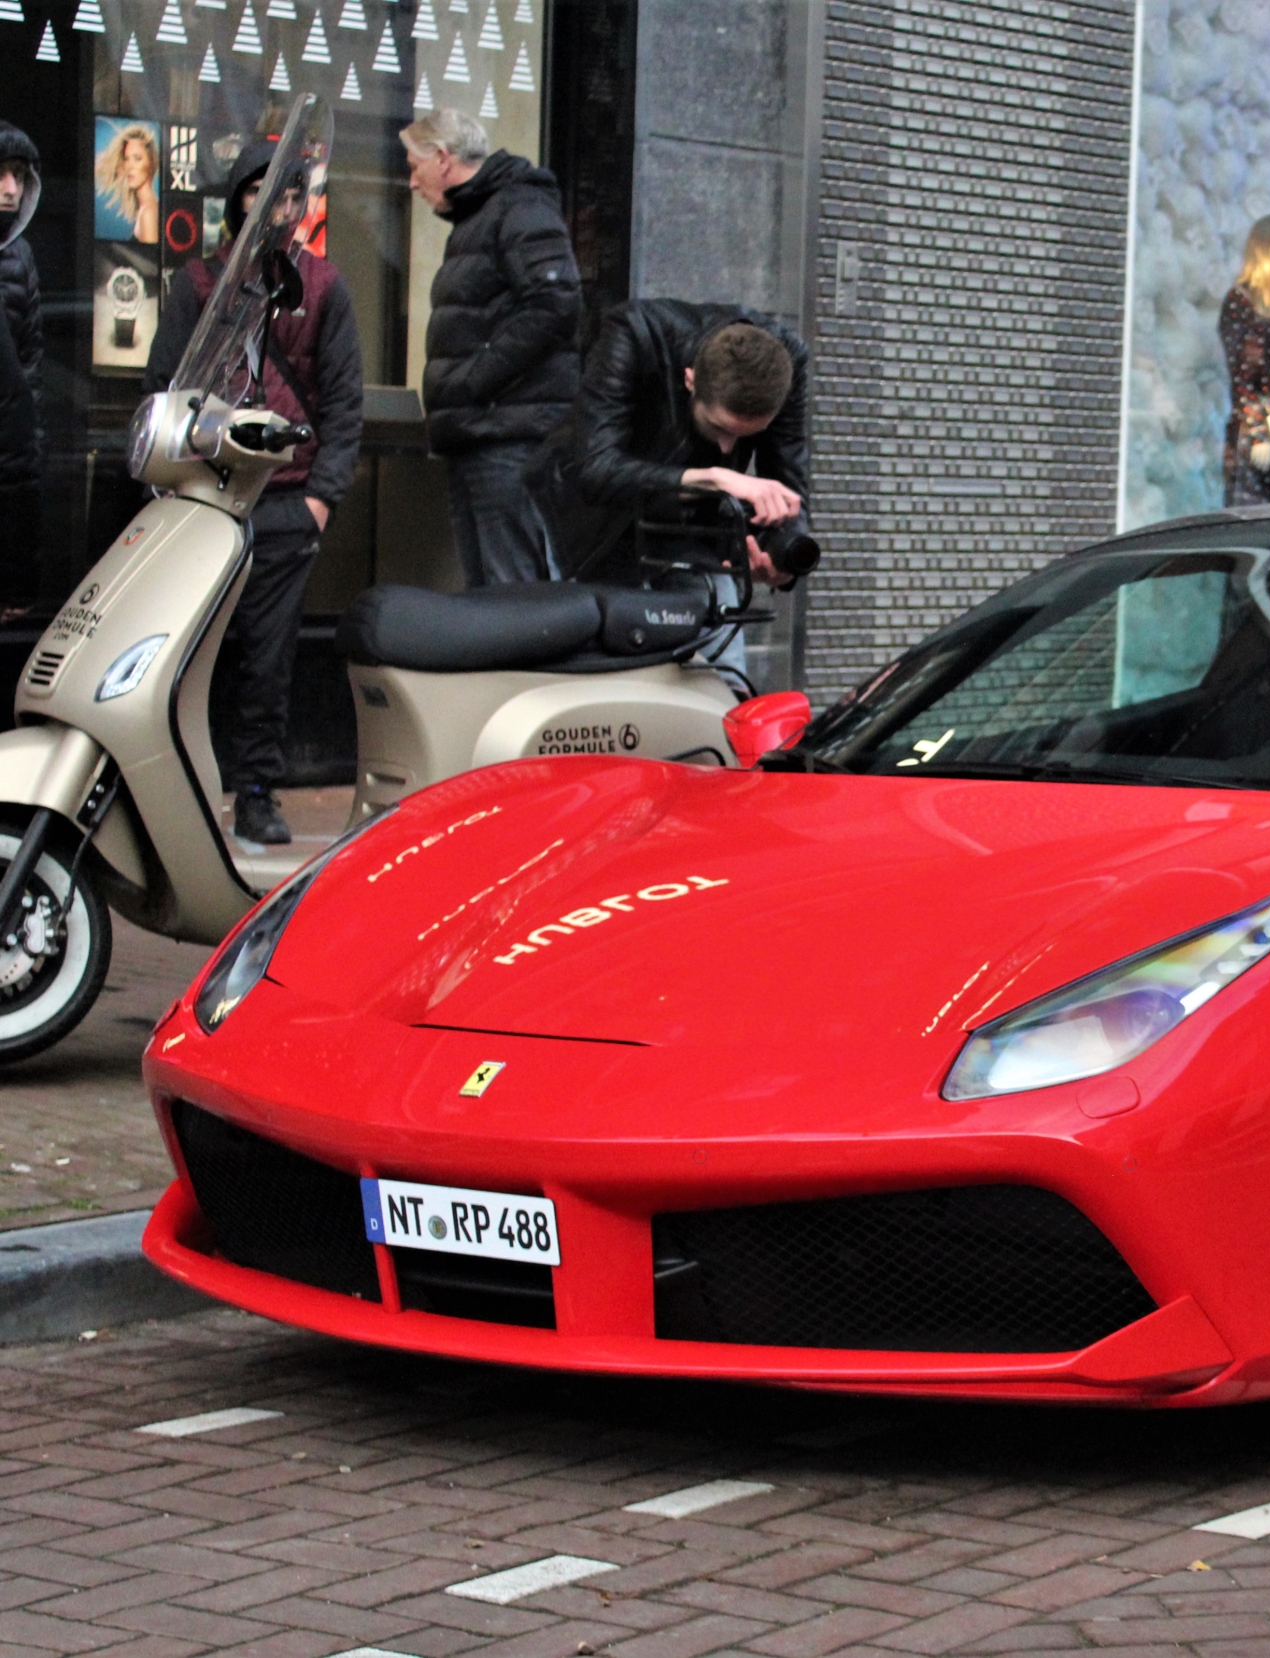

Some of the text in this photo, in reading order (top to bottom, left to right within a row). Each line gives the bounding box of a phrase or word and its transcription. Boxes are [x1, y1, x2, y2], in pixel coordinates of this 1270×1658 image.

[170, 168, 197, 191] XL
[542, 726, 611, 742] GOUDEN
[538, 740, 616, 755] FORMULE
[370, 1218, 378, 1230] D
[387, 1194, 551, 1252] NT RP 488
